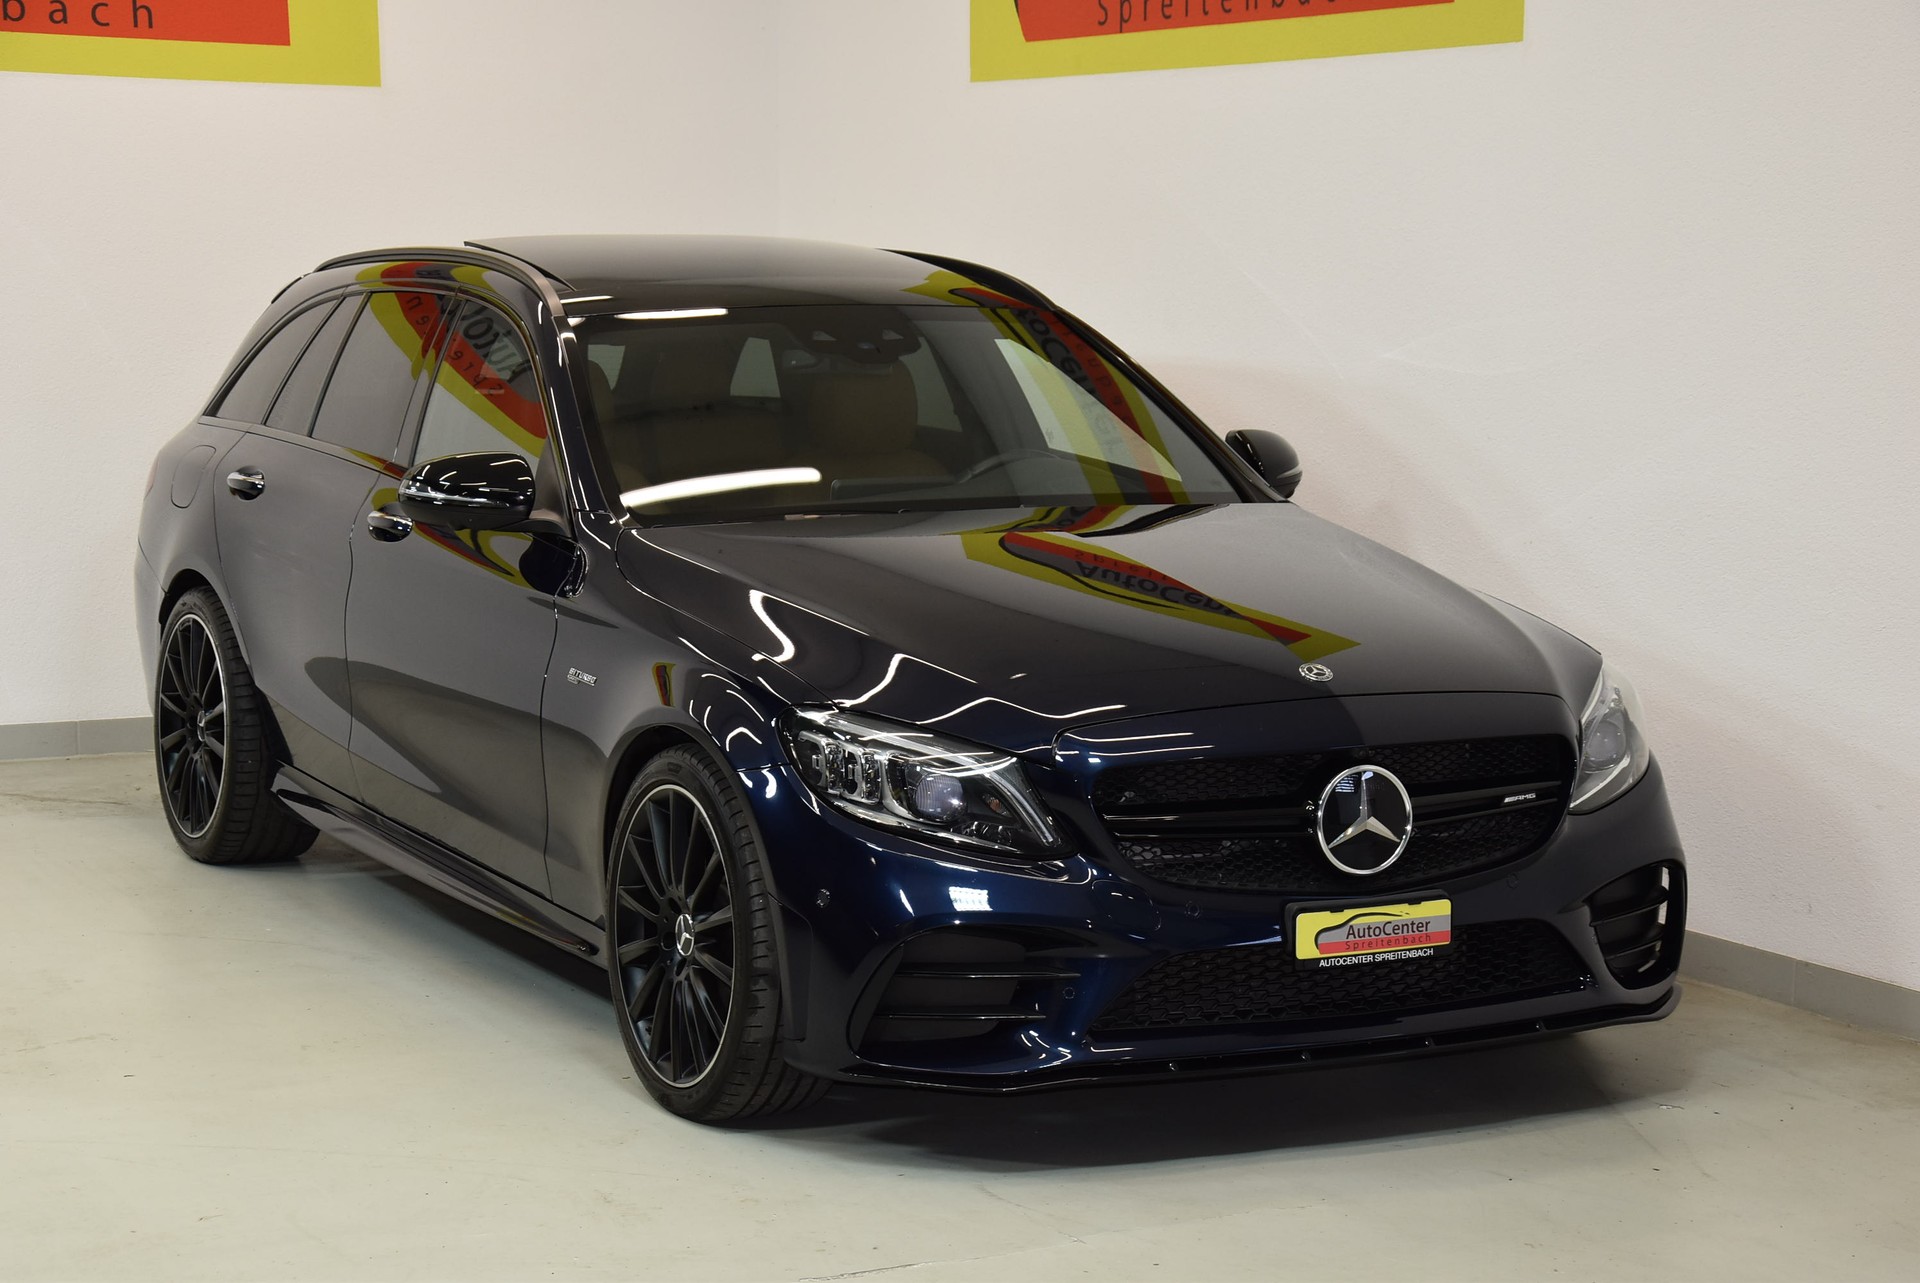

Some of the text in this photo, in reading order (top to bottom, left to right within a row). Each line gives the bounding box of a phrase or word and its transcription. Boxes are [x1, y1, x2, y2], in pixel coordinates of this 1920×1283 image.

[1345, 921, 1431, 939] AutoCenter
[1345, 933, 1432, 952] Spreitenbach
[1319, 948, 1434, 968] AUTOCENTER SPREITENBACH
